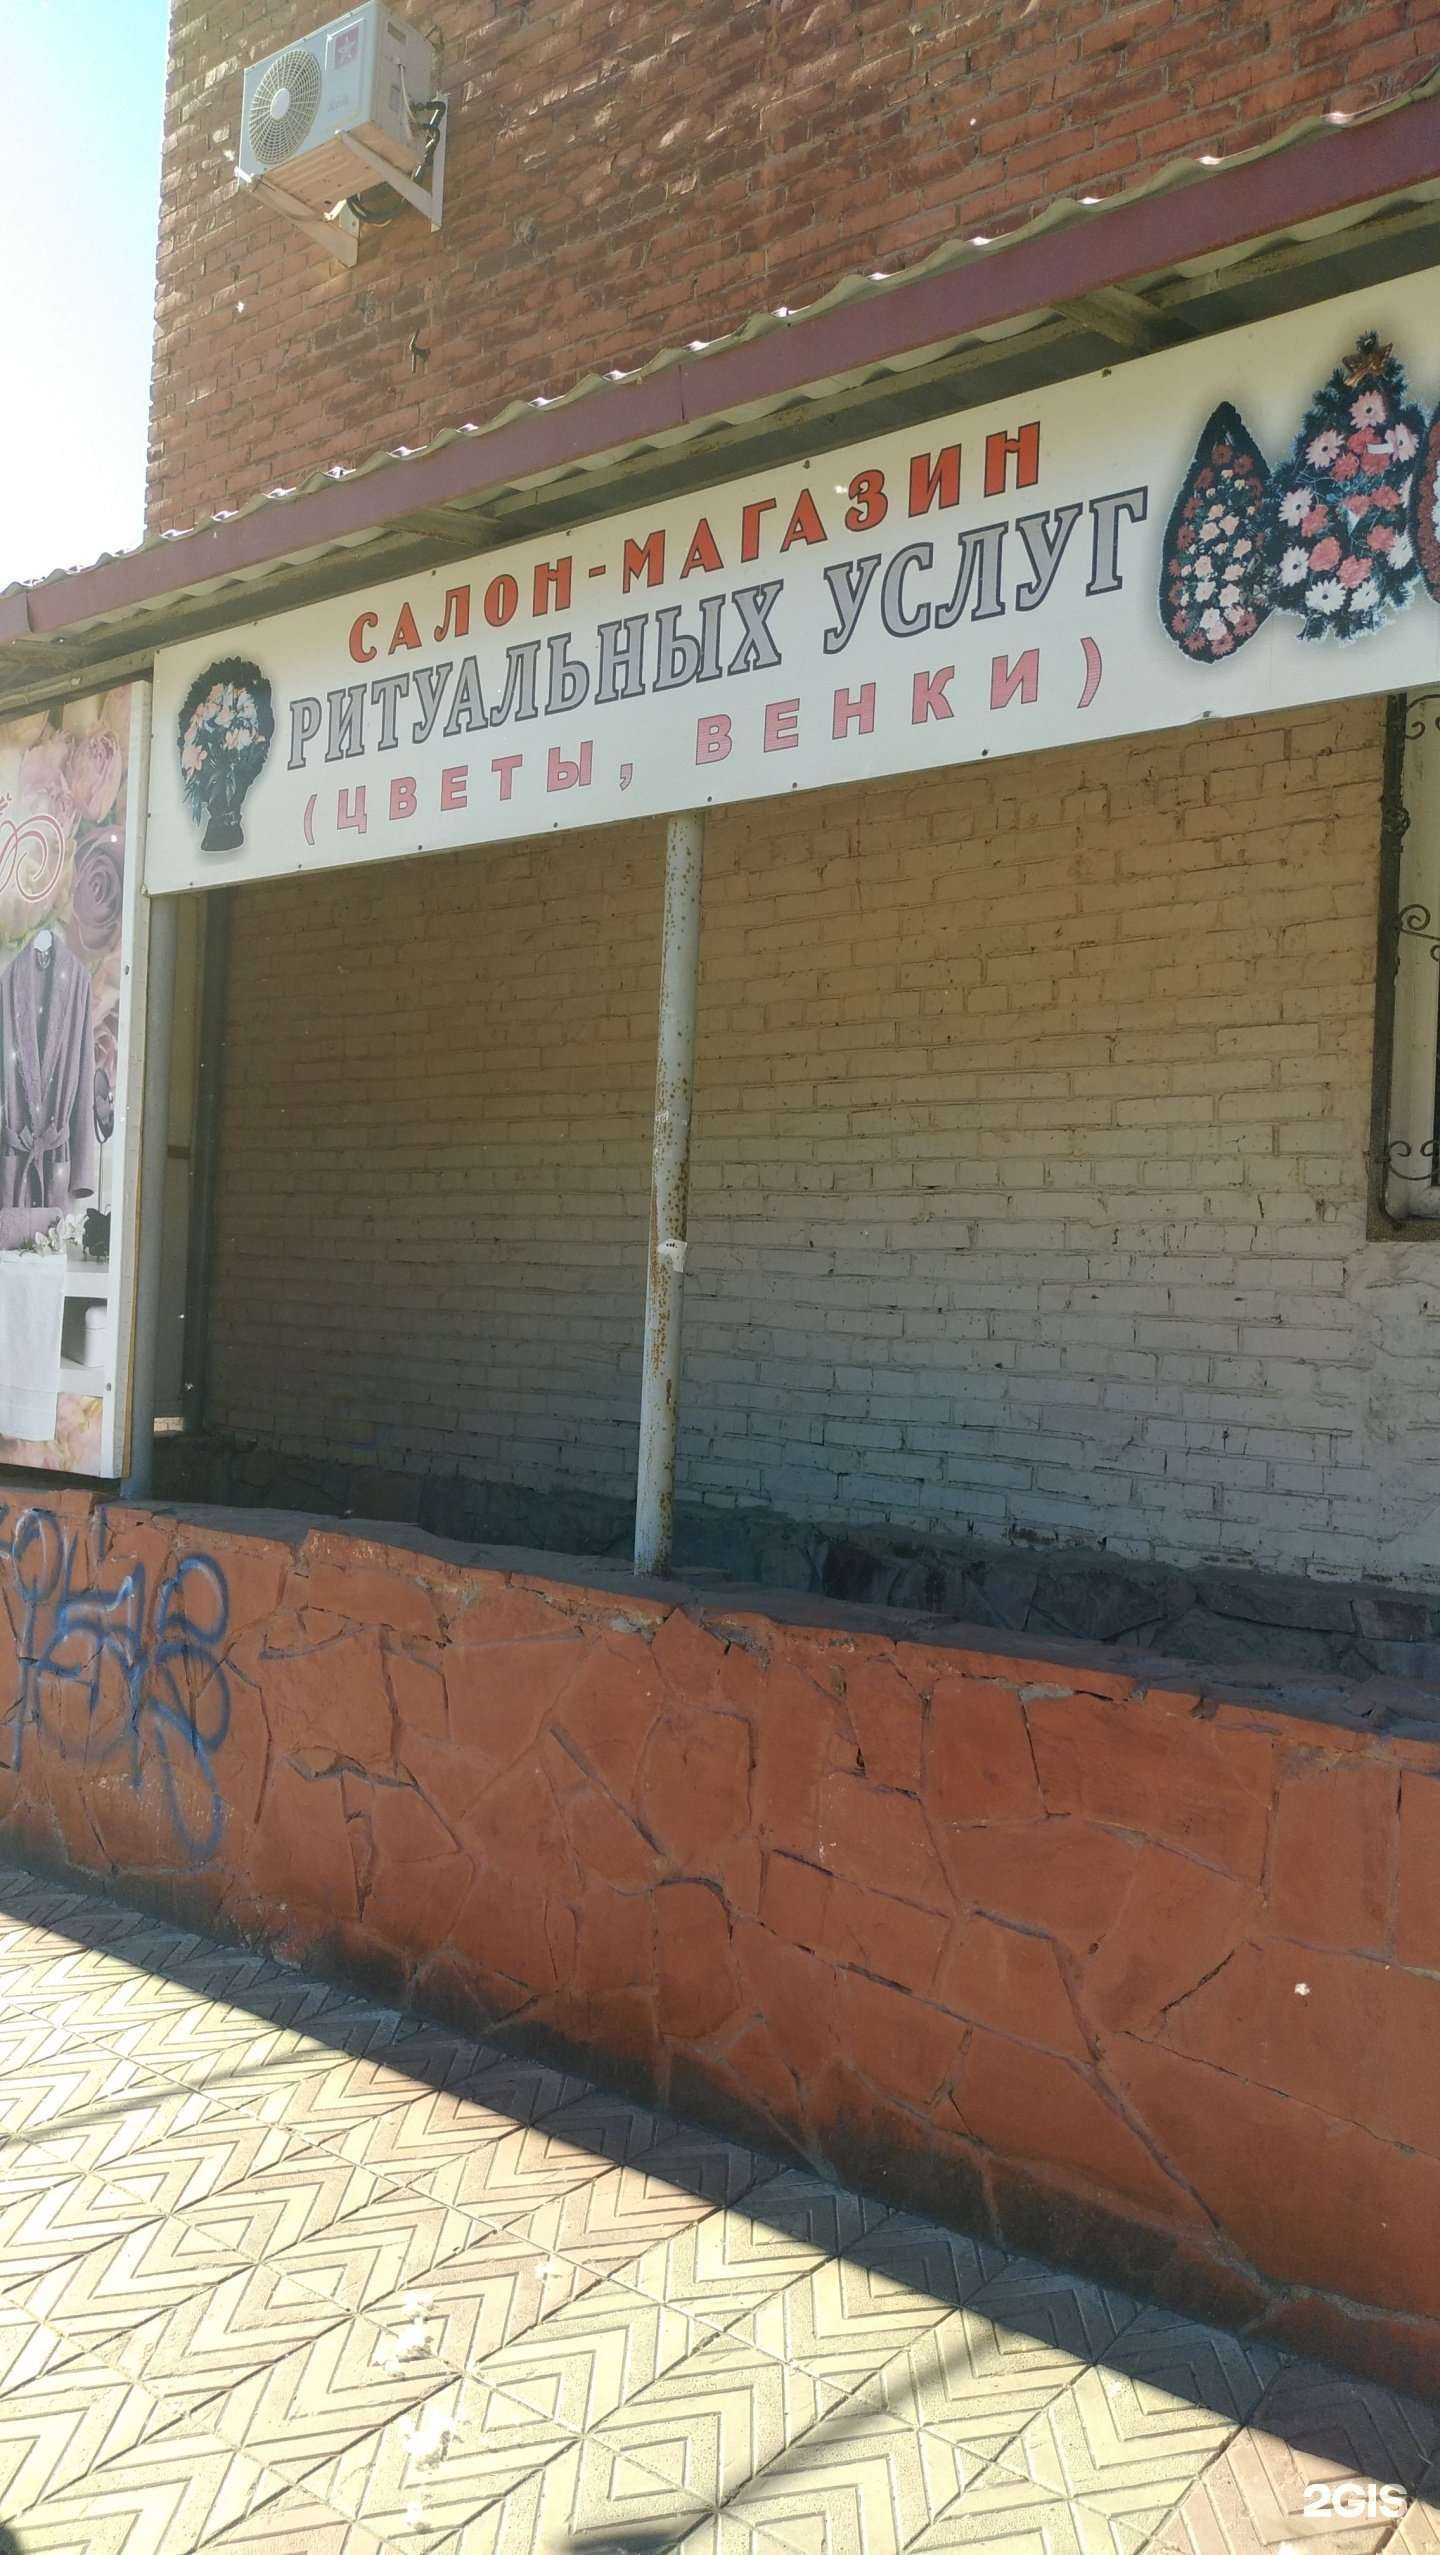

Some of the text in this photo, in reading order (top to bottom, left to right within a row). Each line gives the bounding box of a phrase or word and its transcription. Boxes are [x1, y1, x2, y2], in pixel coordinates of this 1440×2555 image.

[287, 486, 1149, 770] РИТУАЛЬНЫХ УСЛУГ
[348, 421, 1041, 663] САЛОН-МАГАЗИН
[302, 637, 1103, 846] (ЦВЕТЫ, ВЕНКИ)
